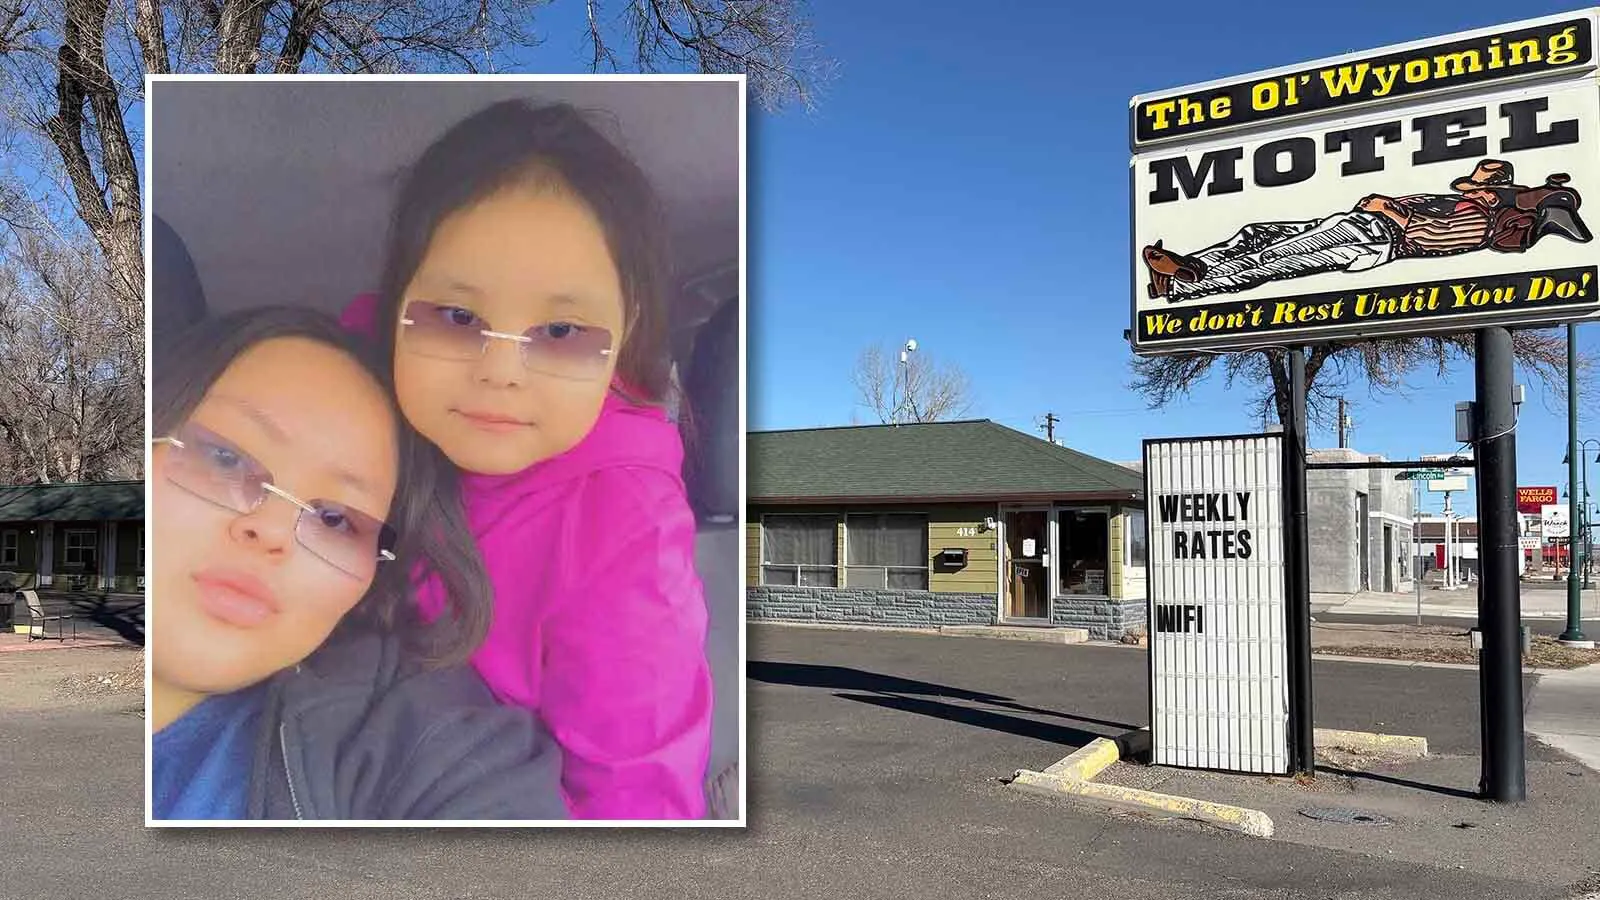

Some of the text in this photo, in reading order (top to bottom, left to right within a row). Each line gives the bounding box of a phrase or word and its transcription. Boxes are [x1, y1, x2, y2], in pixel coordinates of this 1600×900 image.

[1146, 26, 1578, 131] The Ol' Wyoming
[1149, 97, 1579, 205] MOTEL
[1145, 272, 1591, 336] We don't Rest Until You Do!
[1159, 492, 1251, 523] WEEKLY
[1520, 495, 1552, 503] FARGO
[957, 527, 975, 537] 414
[1174, 530, 1252, 560] RATES
[1157, 604, 1203, 634] WIFI
